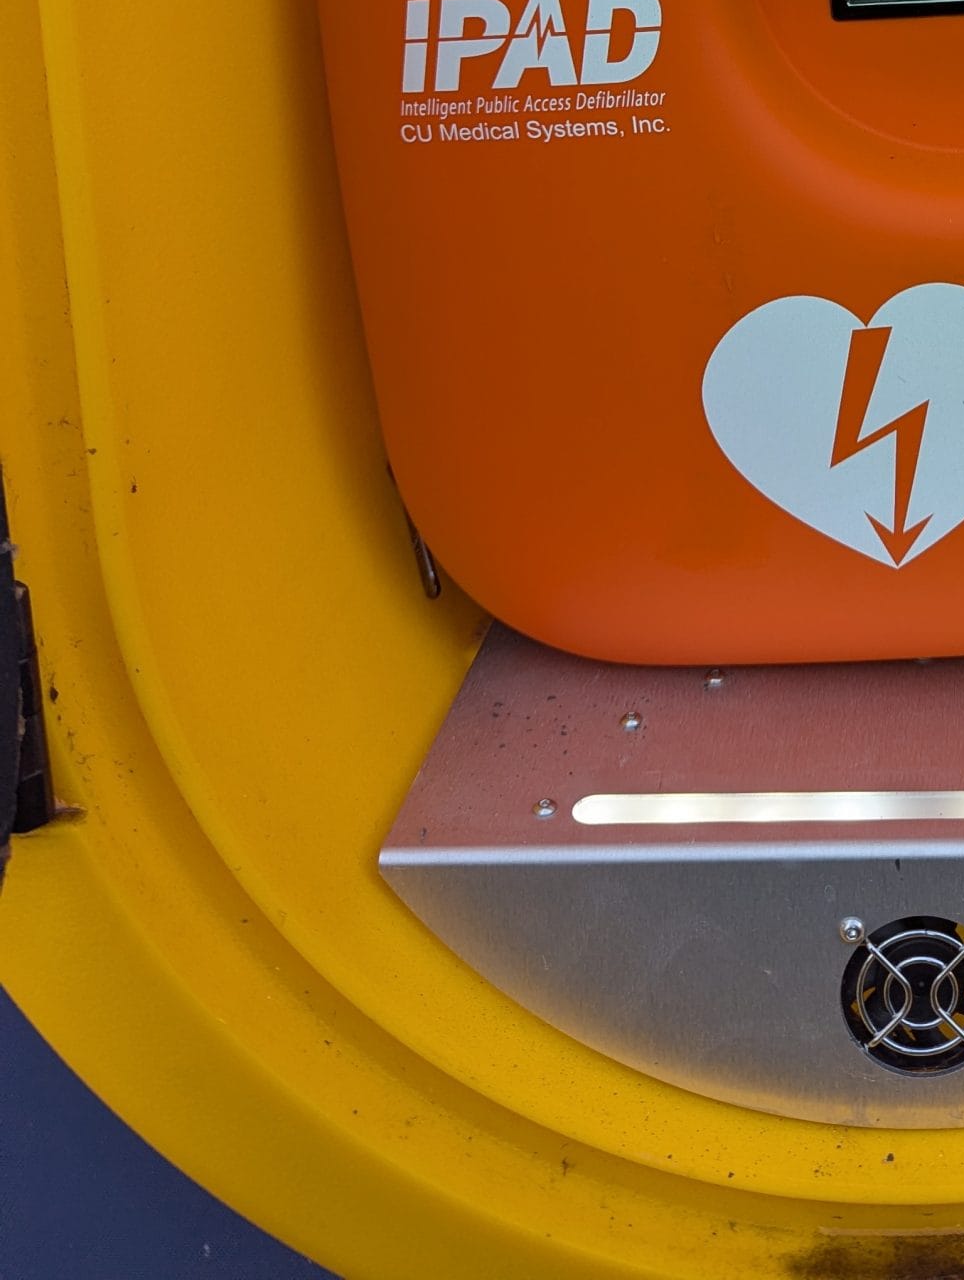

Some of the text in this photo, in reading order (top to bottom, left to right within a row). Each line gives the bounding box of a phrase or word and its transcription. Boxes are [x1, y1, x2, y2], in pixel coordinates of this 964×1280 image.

[401, 90, 666, 119] Intelligent Public Access Defibrillator
[400, 115, 671, 143] CU Medical Systems, Inc.
